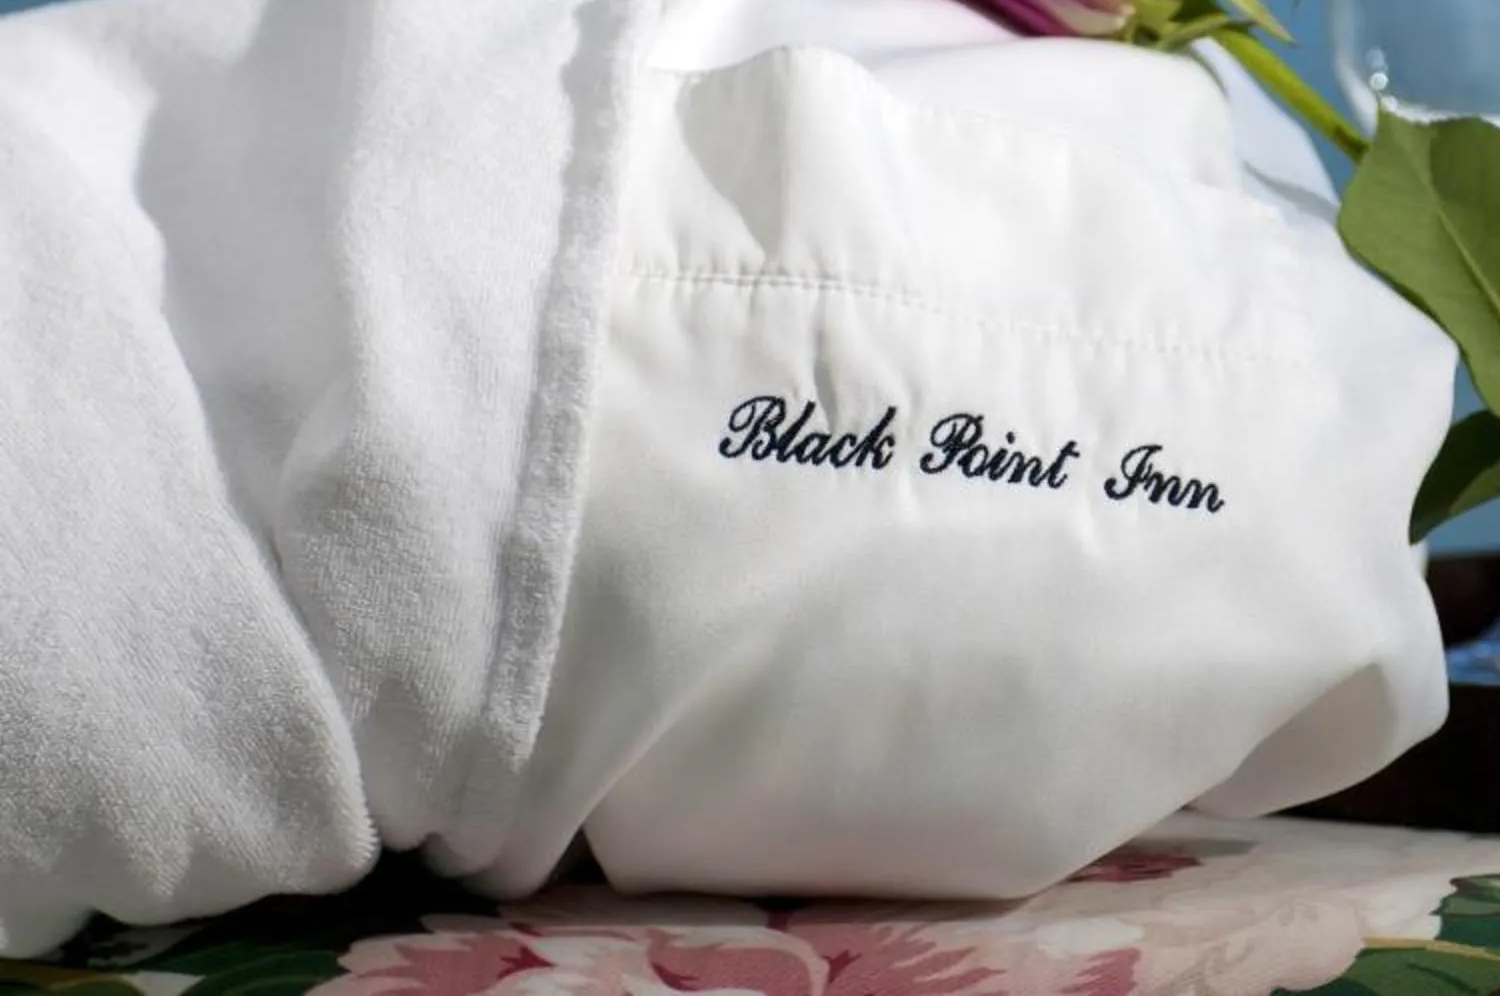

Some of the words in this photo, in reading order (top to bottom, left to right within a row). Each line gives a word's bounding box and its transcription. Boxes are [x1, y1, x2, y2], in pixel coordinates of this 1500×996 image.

[718, 395, 897, 470] Black
[918, 413, 1081, 490] Point
[1103, 444, 1226, 514] Inn
